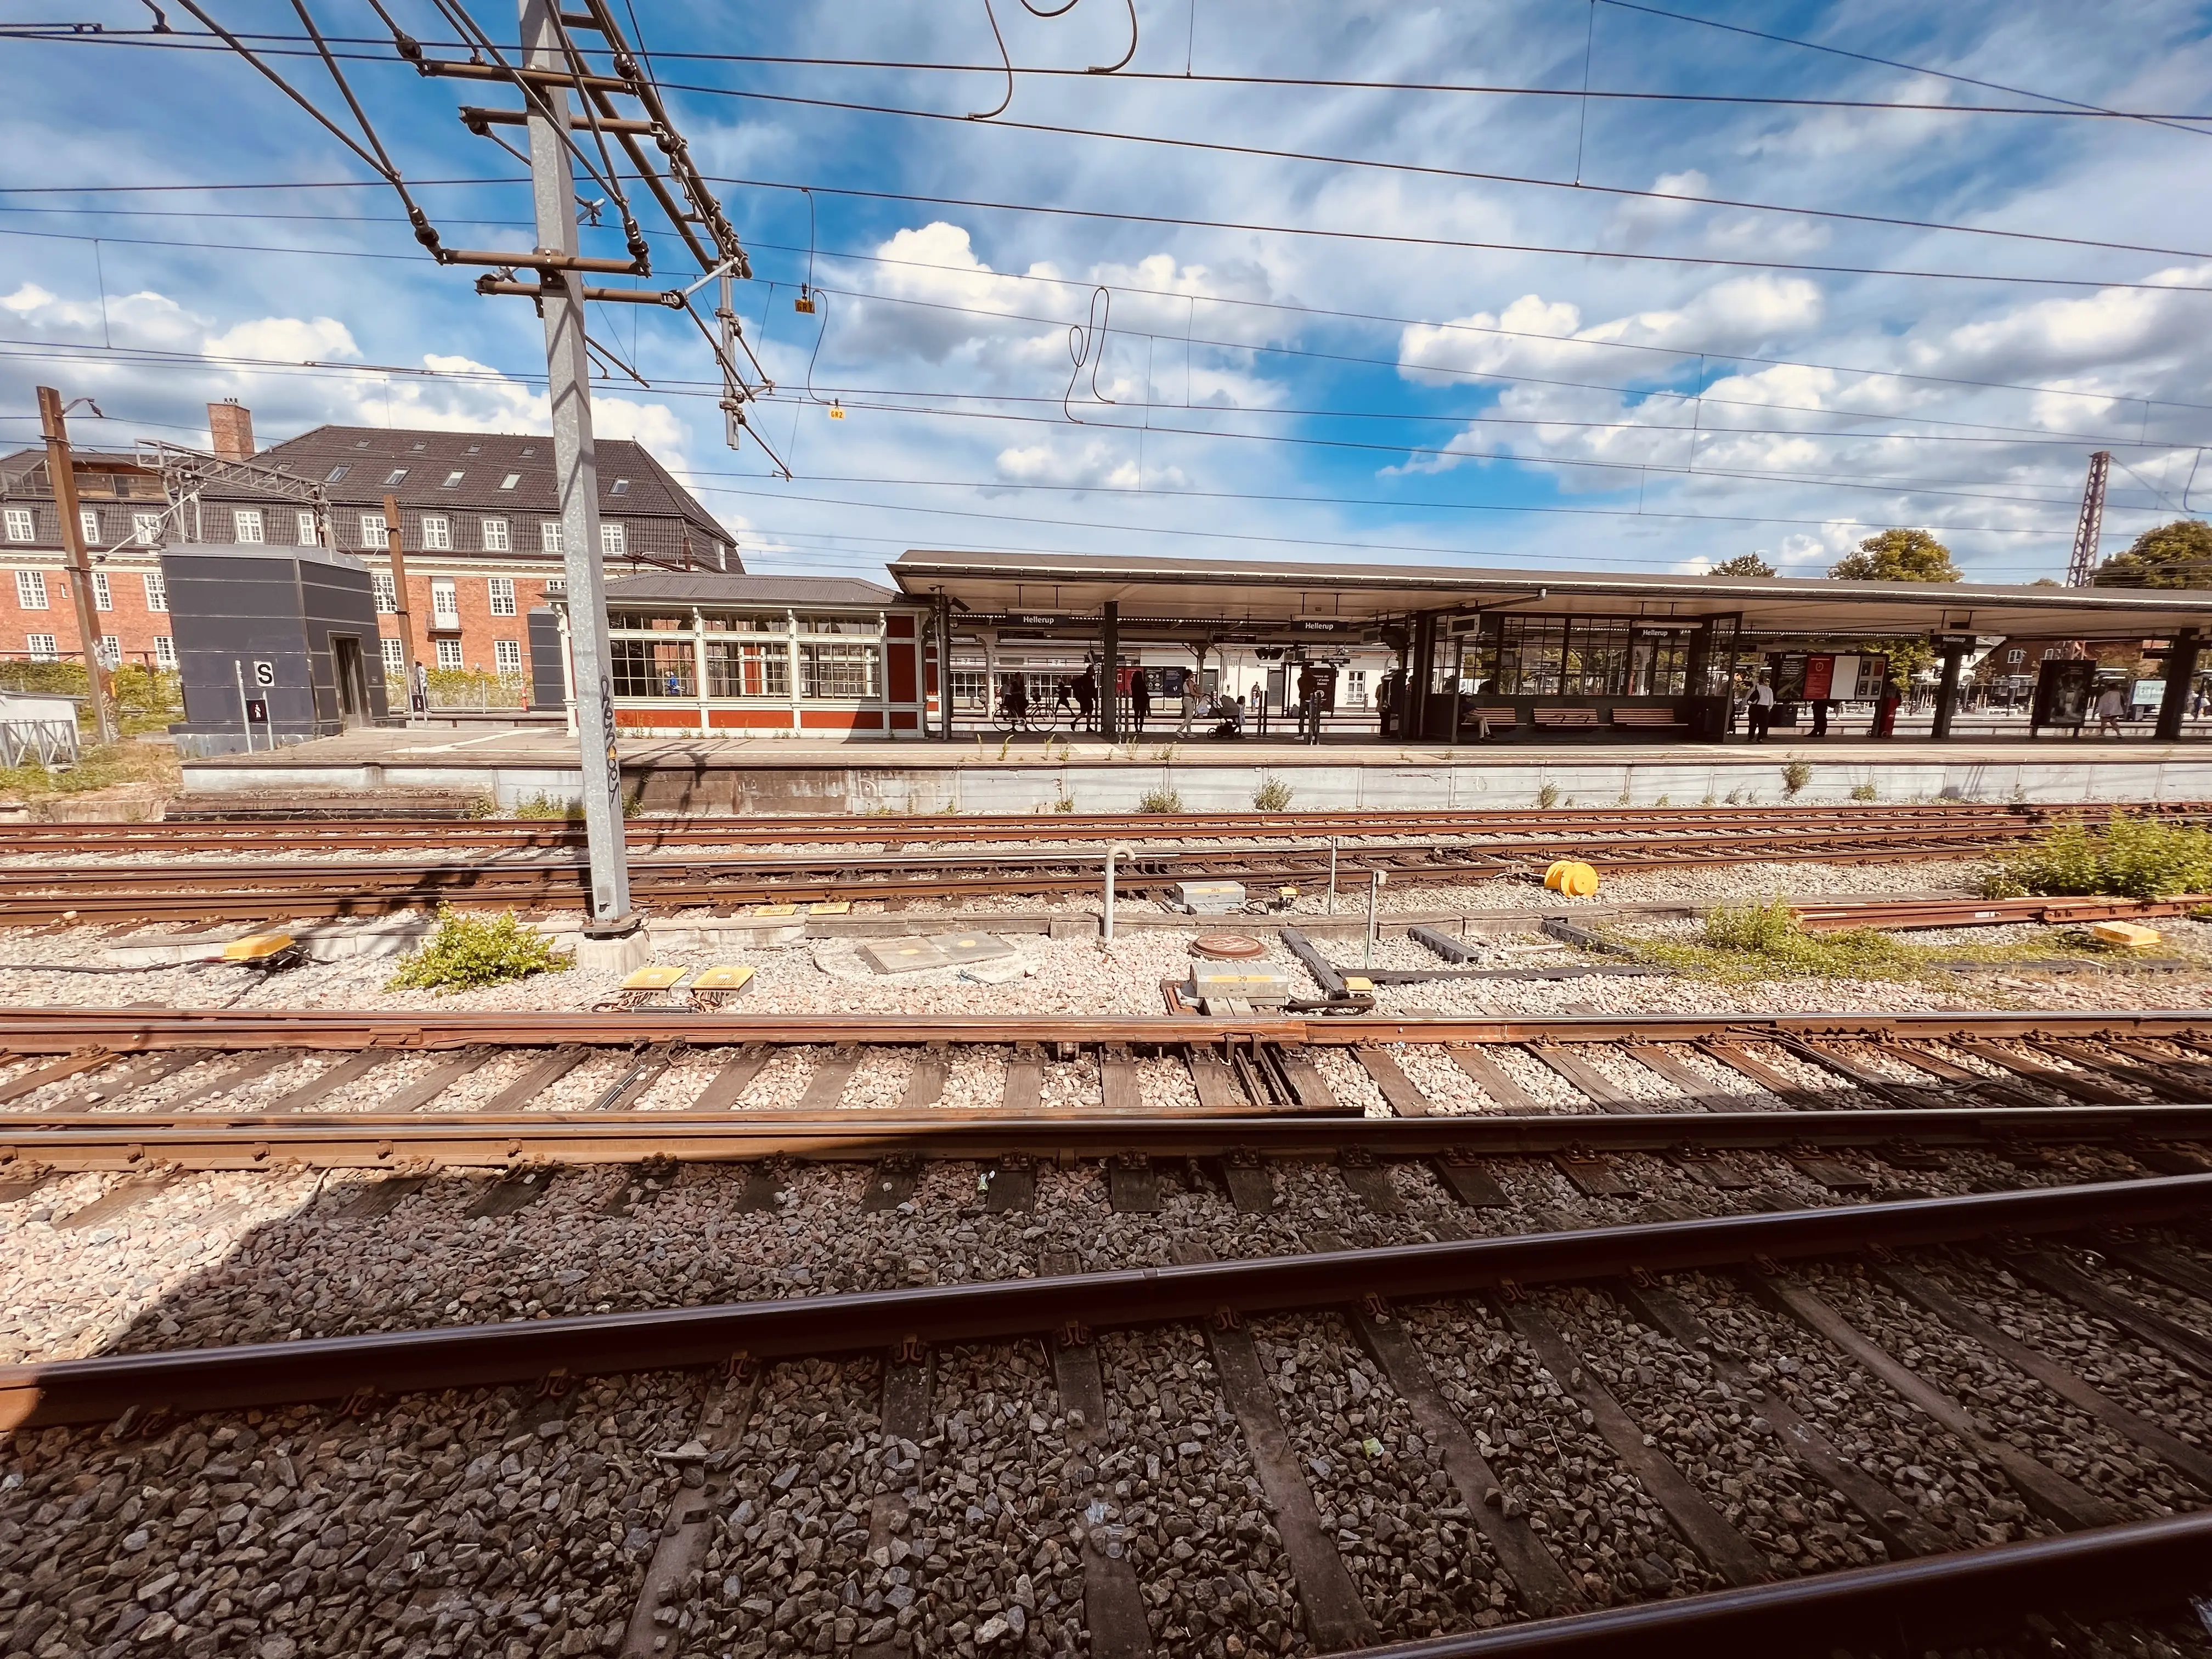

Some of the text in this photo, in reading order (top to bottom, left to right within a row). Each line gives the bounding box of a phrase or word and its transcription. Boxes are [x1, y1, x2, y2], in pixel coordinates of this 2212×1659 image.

[1023, 616, 1054, 625] Hellerup
[1305, 622, 1334, 631] Hellerup
[258, 664, 272, 684] S
